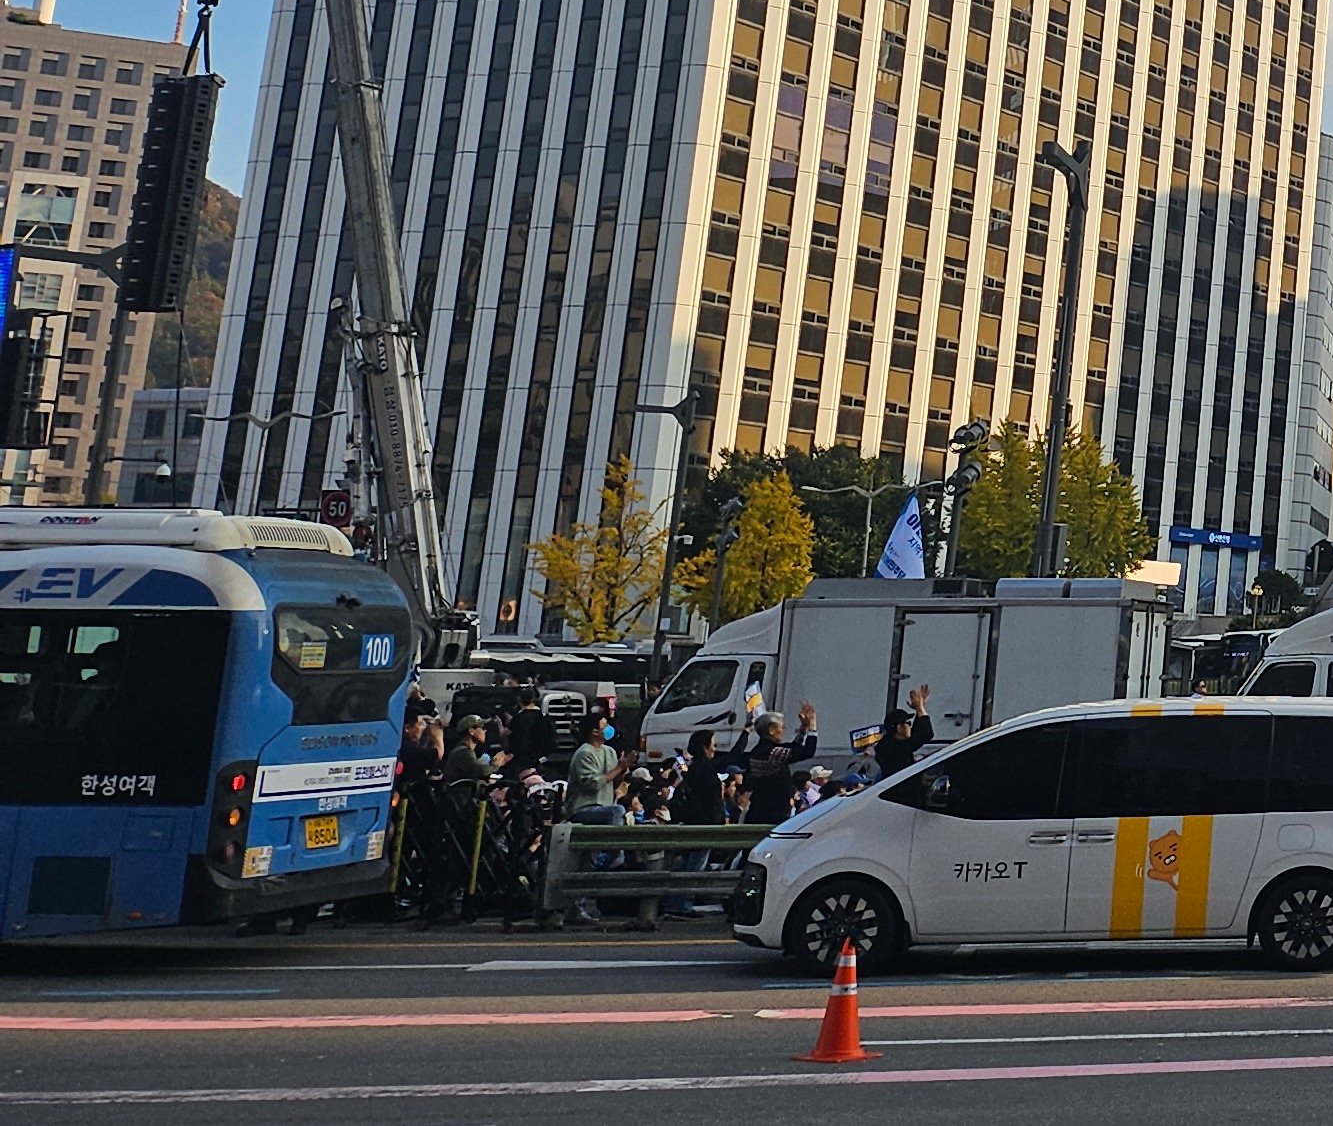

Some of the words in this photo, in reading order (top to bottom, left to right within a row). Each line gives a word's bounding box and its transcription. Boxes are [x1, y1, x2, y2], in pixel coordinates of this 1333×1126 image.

[376, 335, 389, 371] KATO
[329, 501, 347, 517] 50
[30, 567, 125, 599] EV
[365, 637, 391, 667] 100
[81, 774, 156, 796] 한성여객
[953, 861, 1011, 882] 카카오
[1013, 861, 1028, 878] T
